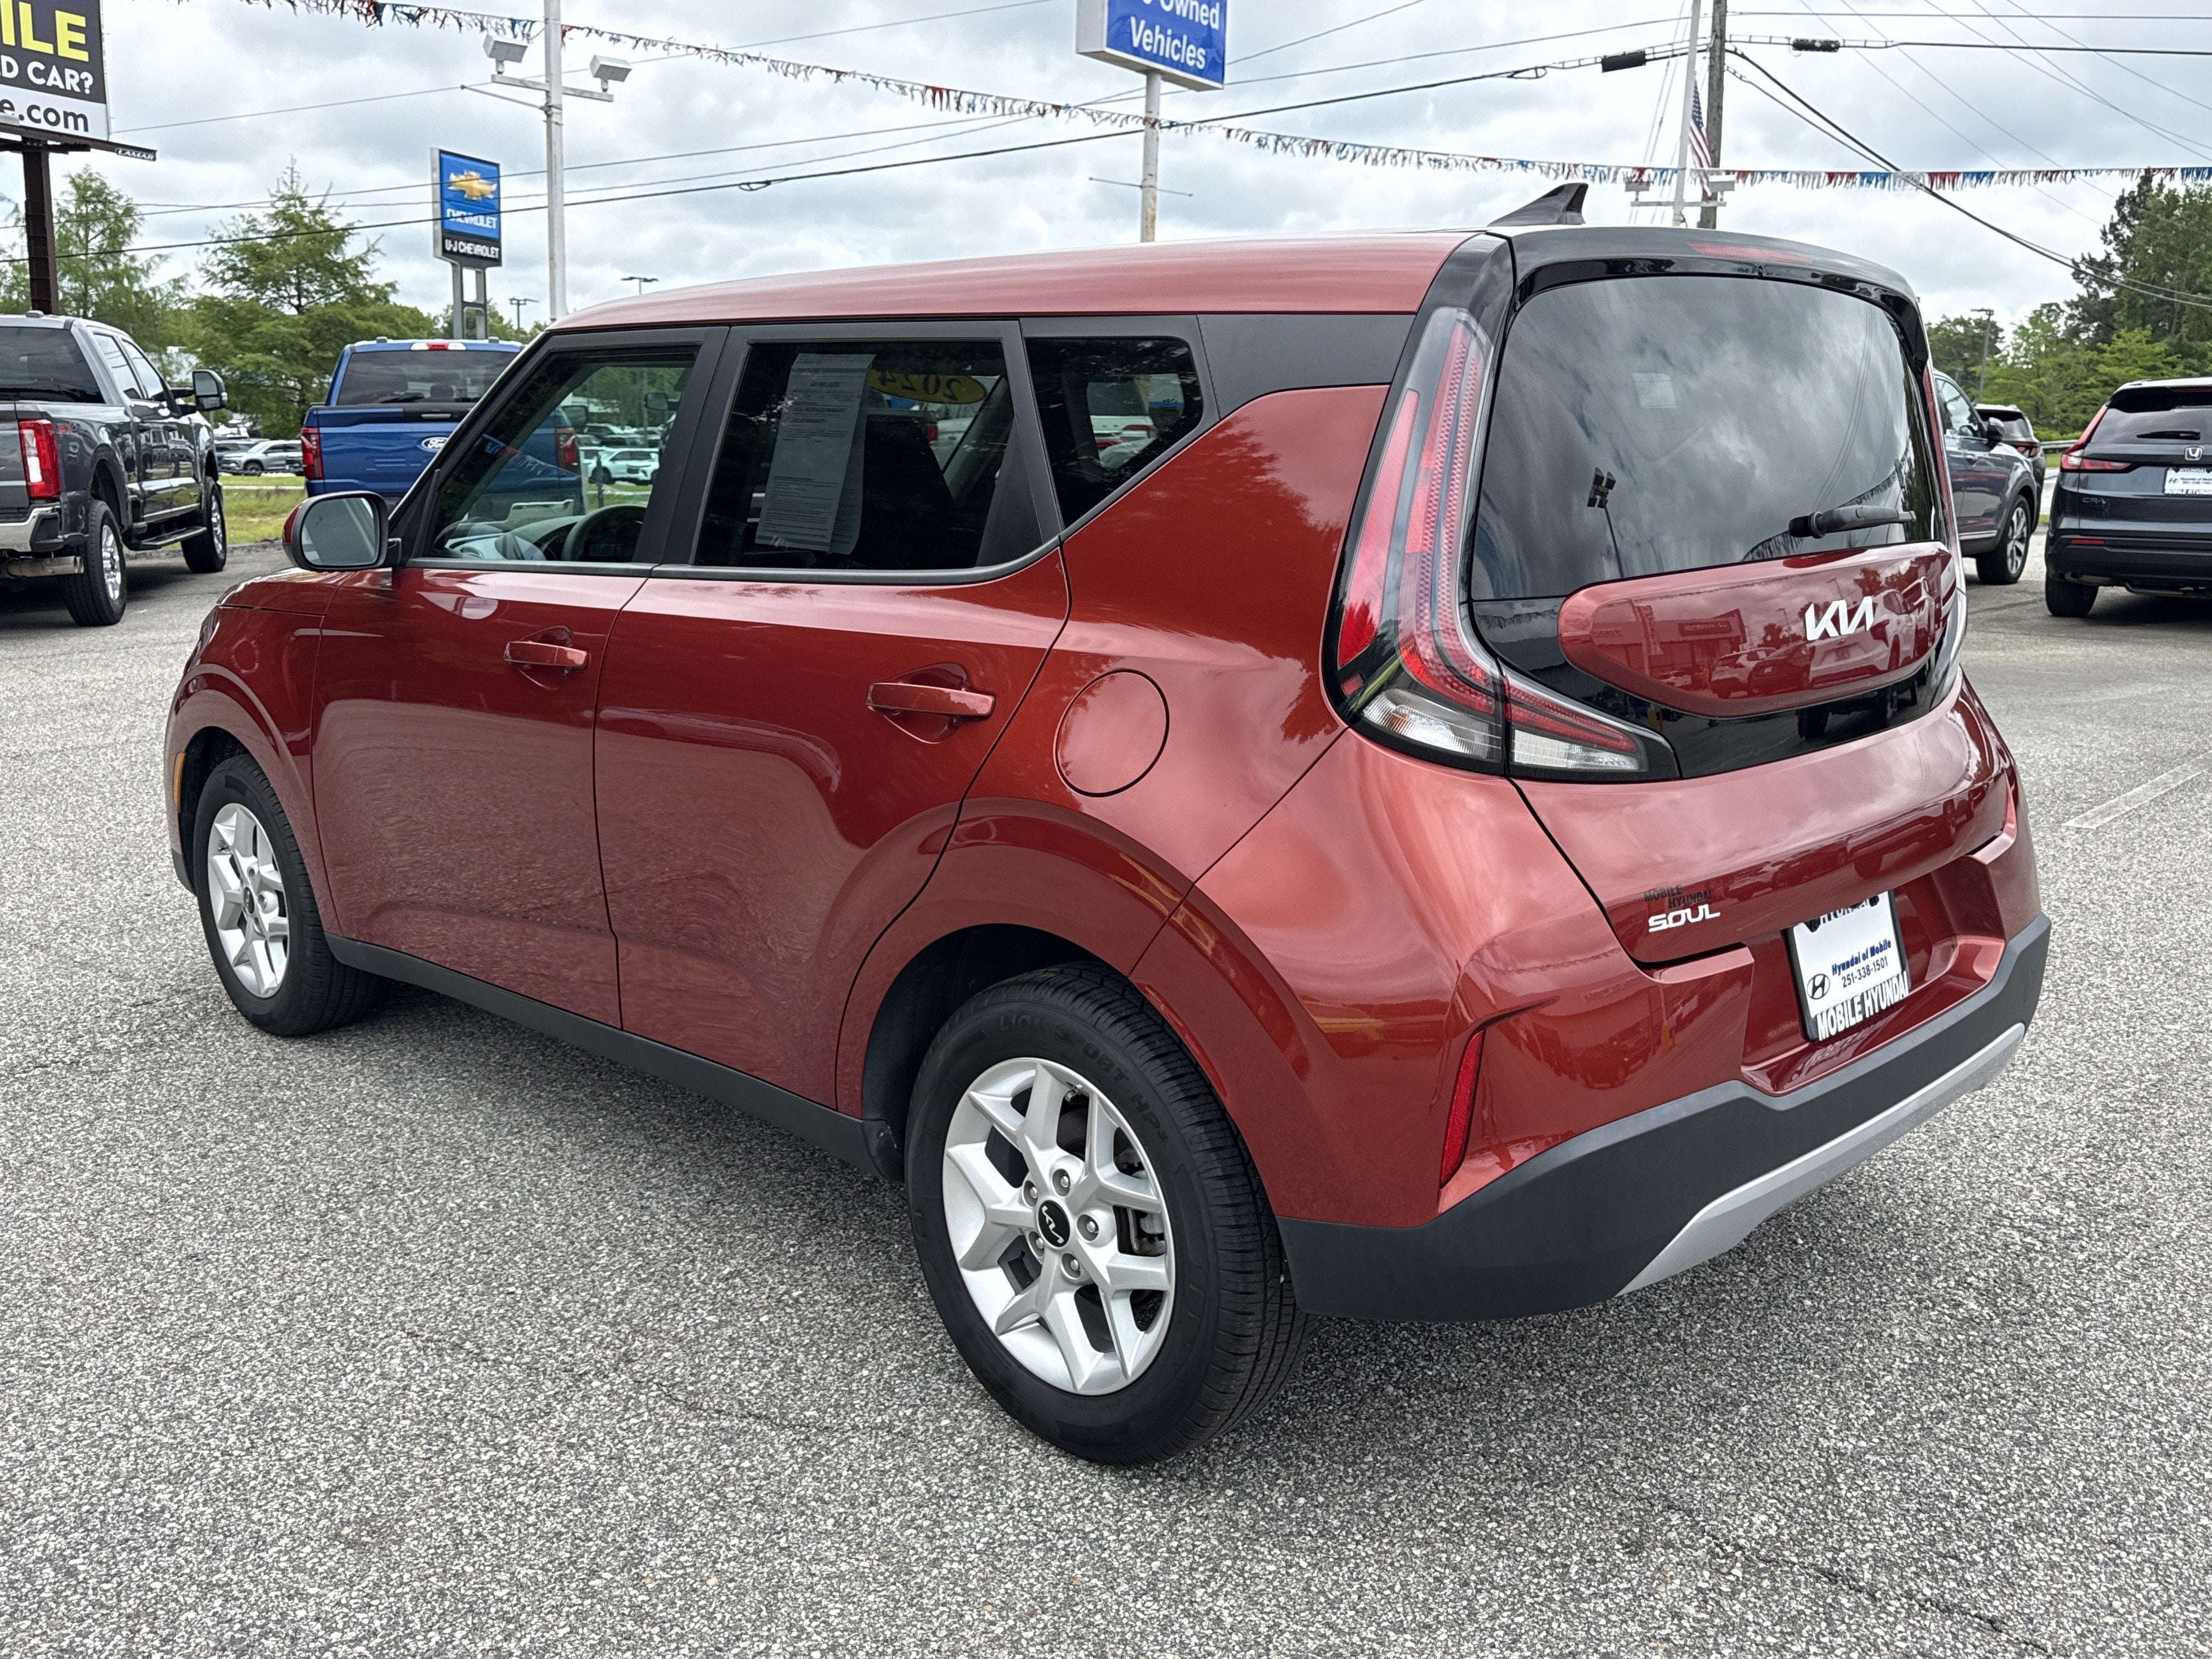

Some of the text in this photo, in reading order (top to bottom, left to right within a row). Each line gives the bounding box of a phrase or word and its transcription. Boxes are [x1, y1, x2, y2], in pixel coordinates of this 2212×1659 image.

[1130, 16, 1206, 69] Vehicles
[27, 61, 93, 94] CAR?
[117, 148, 154, 160] LAMAR
[446, 208, 498, 229] CHEVROLET
[459, 241, 500, 259] CHEVROLET
[1805, 596, 1874, 641] KIA
[1643, 885, 1683, 902] MOBILE
[1668, 890, 1712, 909] HYUNDAI
[1648, 904, 1721, 933] SOUL
[1832, 938, 1892, 977] Hyundai of Mobile
[1842, 955, 1888, 988] 251-338-1501
[1816, 970, 1909, 1041] MOBILE HYUNDAI
